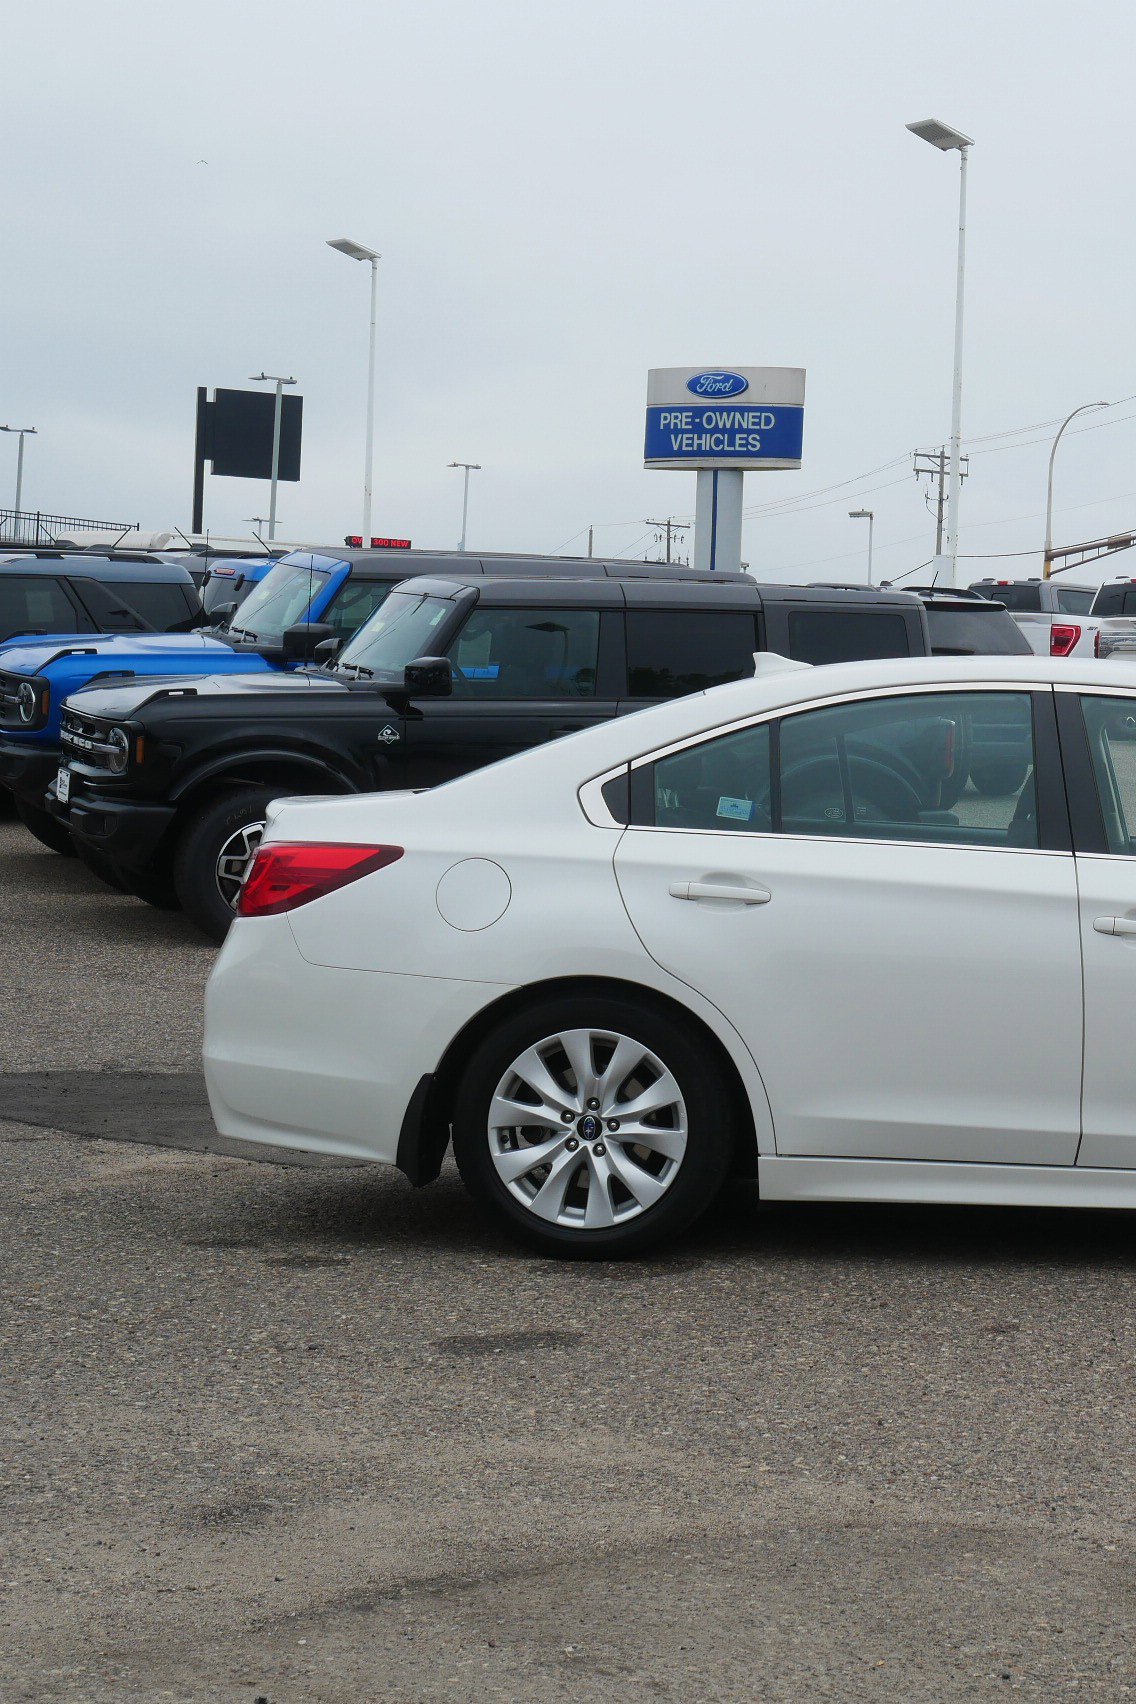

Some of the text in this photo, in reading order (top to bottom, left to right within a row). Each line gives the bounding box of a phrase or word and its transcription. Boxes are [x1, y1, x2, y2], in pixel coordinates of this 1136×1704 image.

[696, 374, 734, 393] Ford
[659, 411, 776, 430] PRE-OWNED
[670, 433, 761, 451] VEHICLES
[373, 538, 388, 546] 300
[390, 539, 409, 547] NEW
